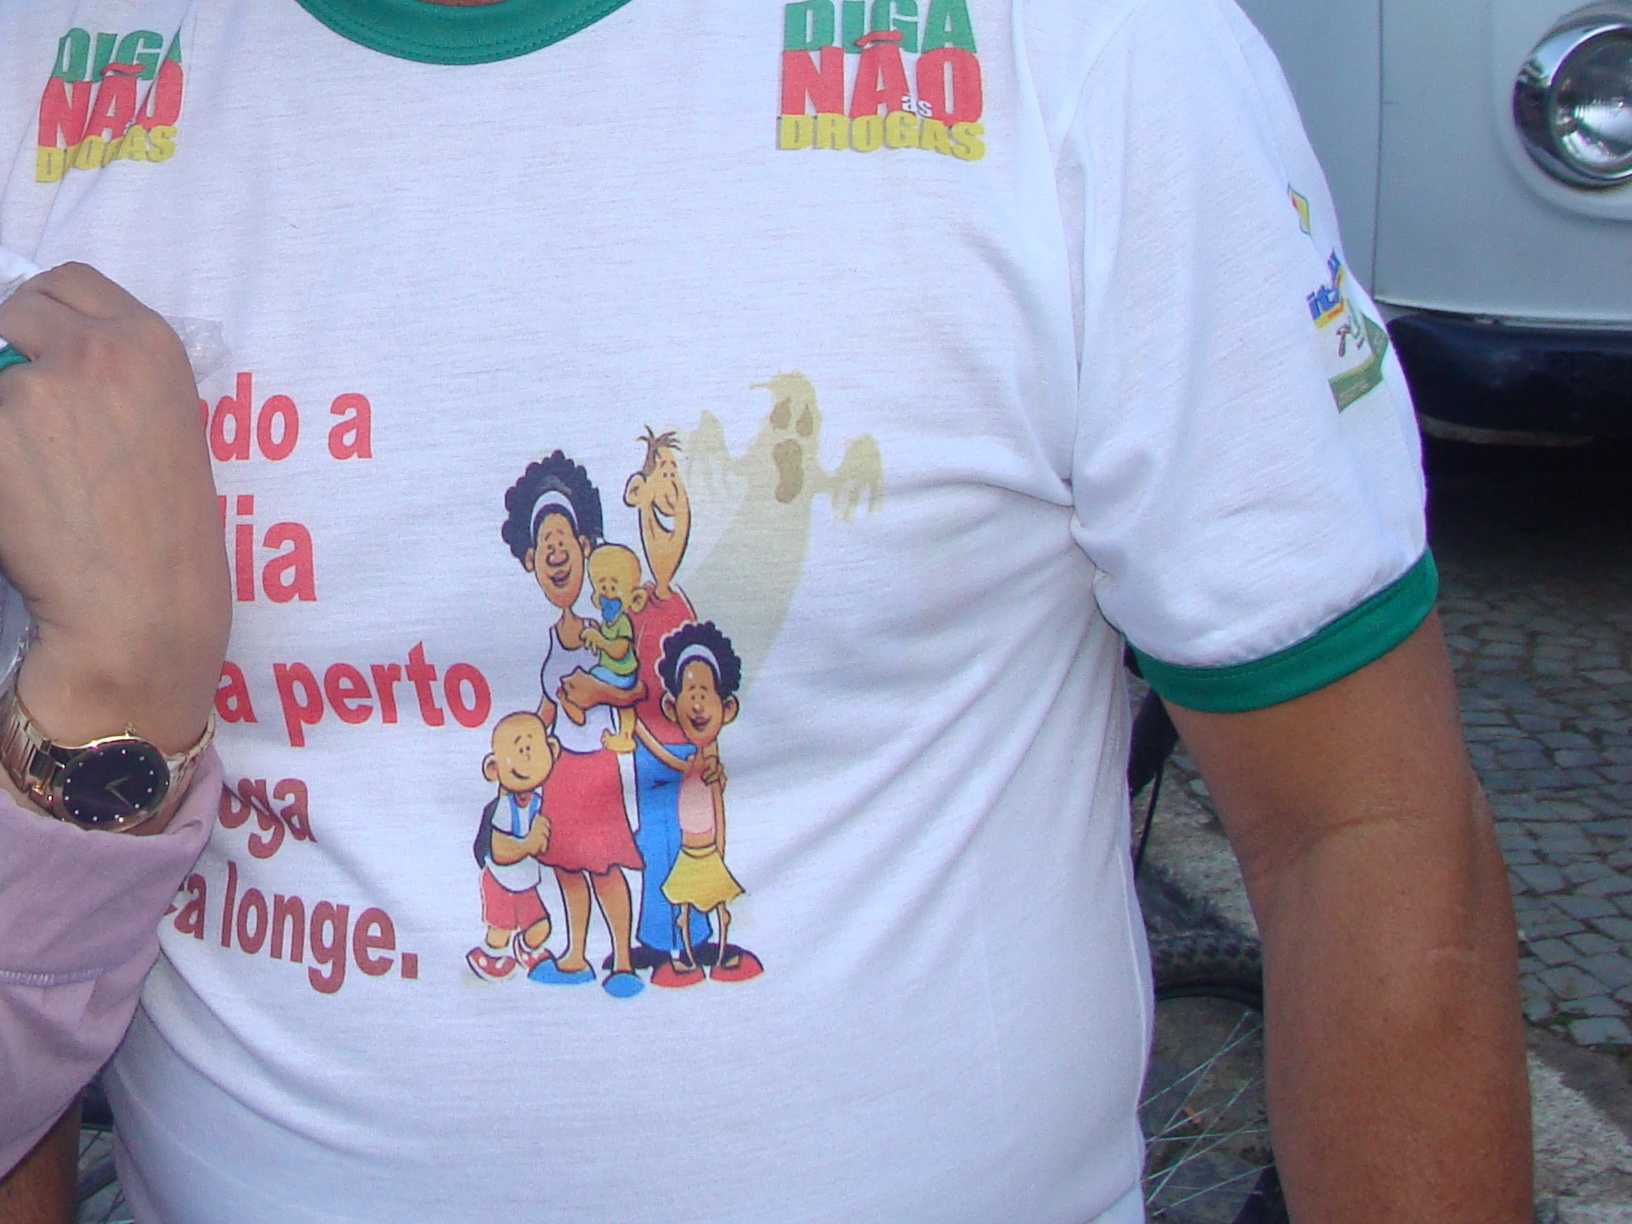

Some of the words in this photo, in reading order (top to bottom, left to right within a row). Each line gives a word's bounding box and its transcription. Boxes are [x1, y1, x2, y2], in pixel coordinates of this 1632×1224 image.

[781, 30, 983, 127] NÃO
[776, 110, 986, 162] DROGAS
[327, 392, 373, 461] a
[272, 640, 492, 747] perto
[220, 860, 419, 994] longe.
